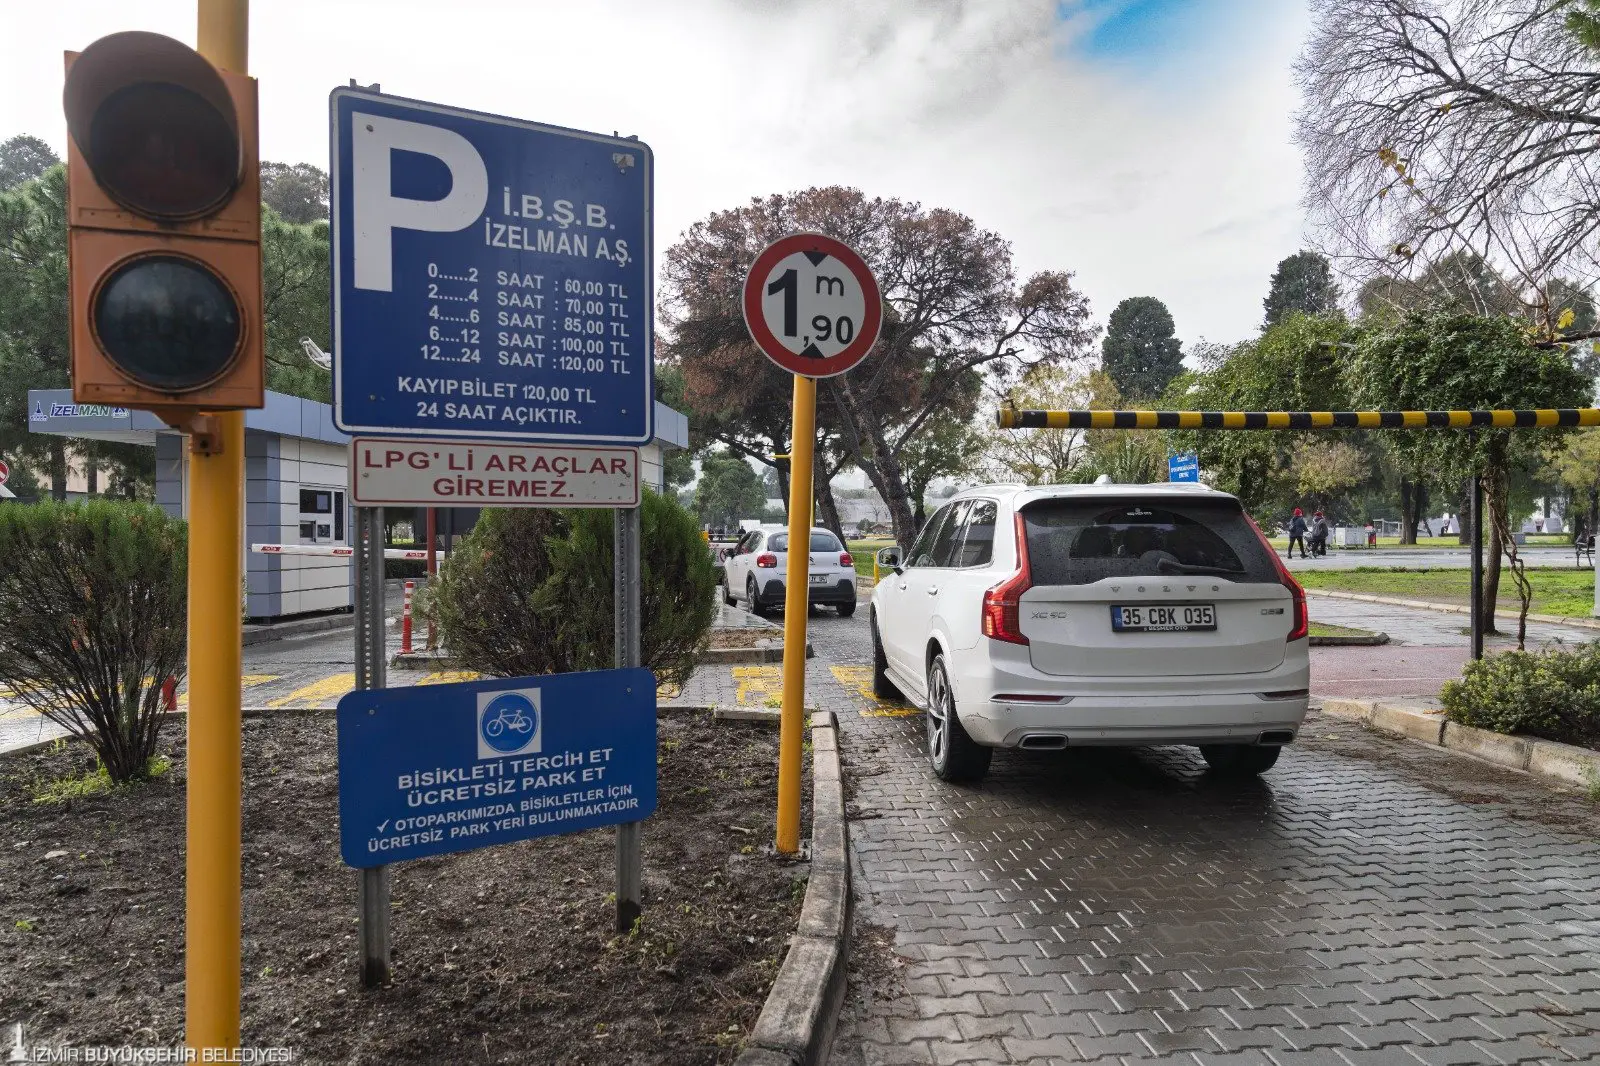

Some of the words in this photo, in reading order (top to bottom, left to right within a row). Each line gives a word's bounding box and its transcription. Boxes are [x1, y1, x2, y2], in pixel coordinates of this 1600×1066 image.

[352, 111, 488, 292] P
[504, 186, 615, 229] İ.B.Ş.B.
[485, 217, 588, 257] İZELMAN
[595, 237, 632, 267] A.Ş.
[497, 271, 544, 289] SAAT
[565, 279, 603, 296] 60,00
[608, 284, 628, 298] TL
[816, 275, 844, 297] m
[497, 291, 544, 309] SAAT
[565, 299, 604, 316] 70,00
[609, 303, 629, 318] TL
[498, 311, 545, 329] SAAT
[564, 317, 604, 335] 85,00
[610, 322, 630, 337] TL
[498, 332, 545, 349] SAAT
[610, 342, 630, 356] TL
[498, 351, 545, 368] SAAT
[611, 360, 630, 374] TL
[522, 385, 569, 404] 120,00
[575, 388, 596, 403] TL
[50, 403, 110, 417] İZELMAN
[416, 402, 438, 417] 24
[444, 403, 496, 420] SAAT
[501, 407, 582, 425] AÇIKTIR.
[485, 455, 627, 477] ARAÇLAR
[433, 475, 574, 498] GİREMEZ.
[1123, 609, 1140, 625] 35
[1149, 608, 1177, 624] CBK
[398, 760, 504, 790] BİSİKLETİ
[510, 751, 583, 774] TERCİH
[589, 748, 613, 763] ET
[407, 778, 516, 807] ÜCRETSİZ
[522, 770, 577, 791] PARK
[582, 766, 606, 782] ET
[395, 803, 515, 831] OTOPARKIMIZDA
[520, 789, 604, 812] BİSİKLETLER
[368, 828, 443, 852] ÜCRETSİZ
[450, 822, 490, 838] PARK
[493, 814, 525, 831] YERİ
[529, 798, 639, 825] BULUNMAKTADIR
